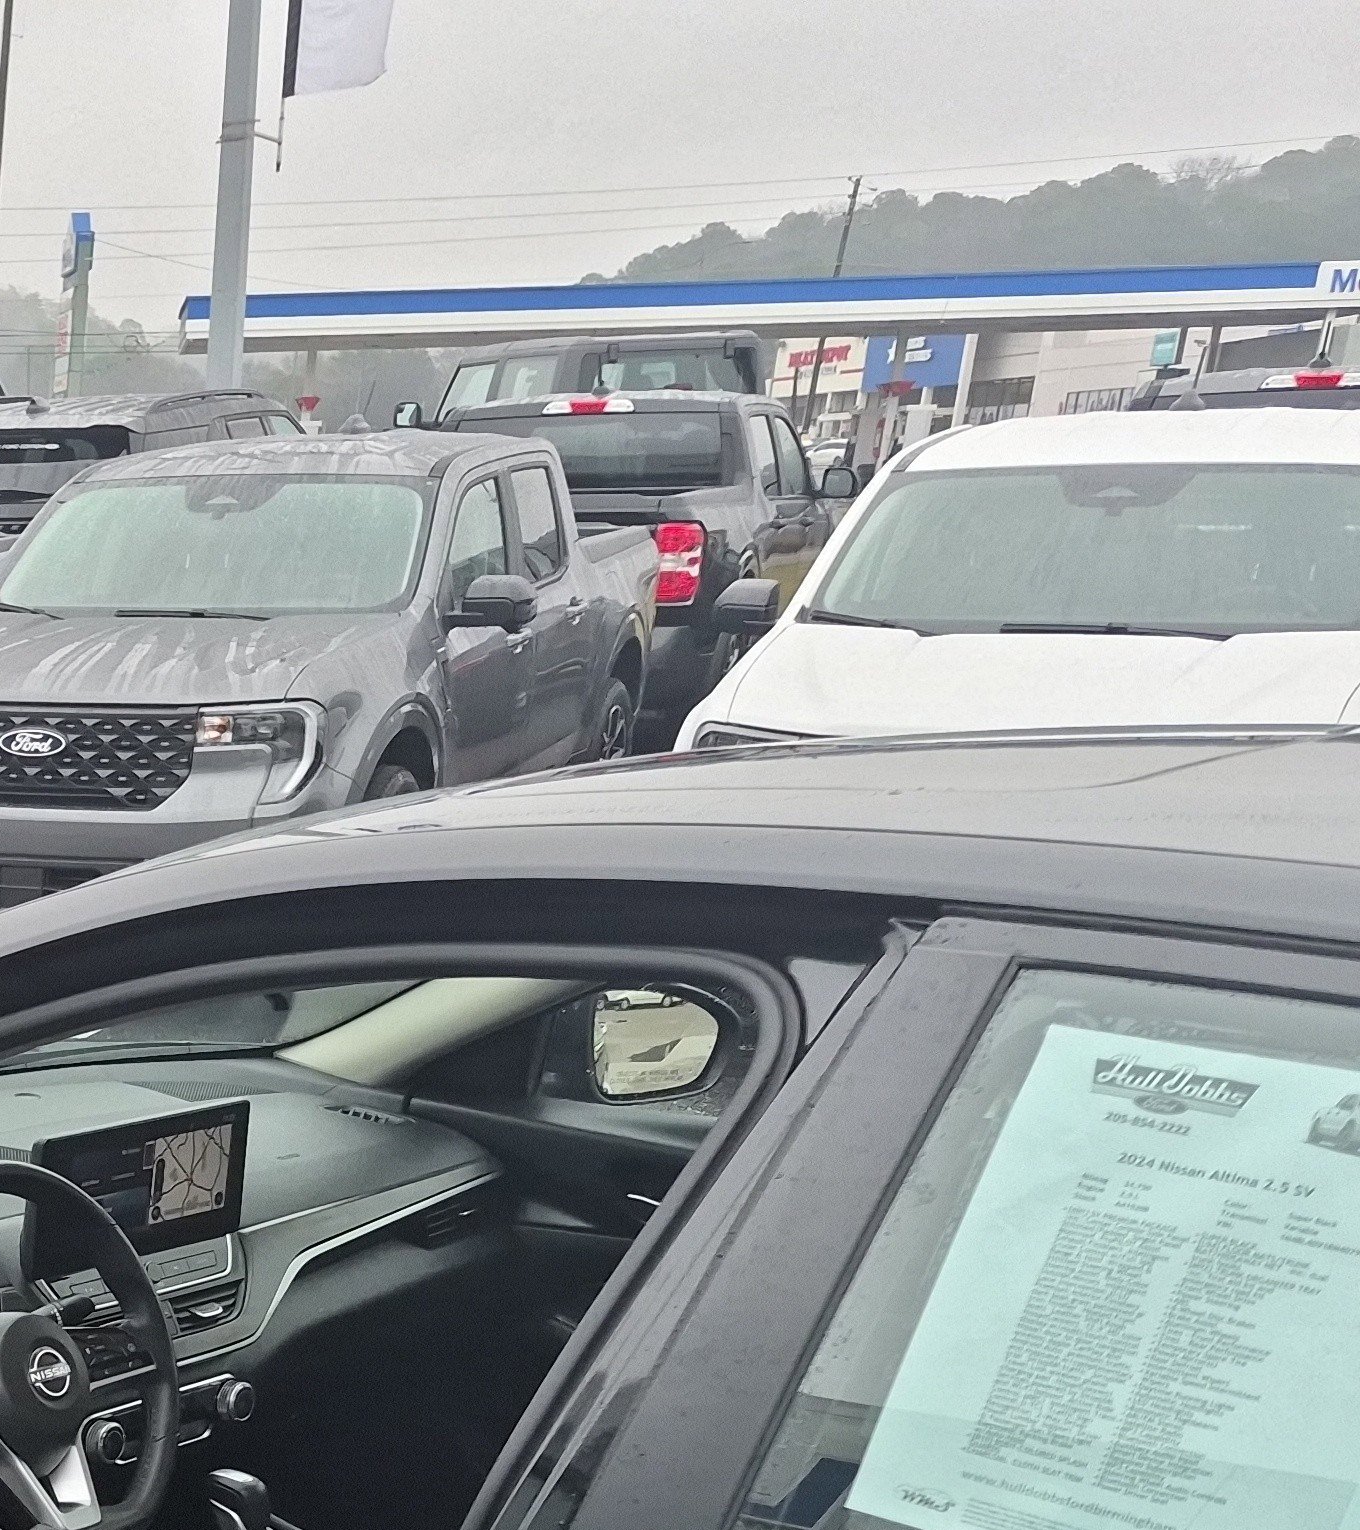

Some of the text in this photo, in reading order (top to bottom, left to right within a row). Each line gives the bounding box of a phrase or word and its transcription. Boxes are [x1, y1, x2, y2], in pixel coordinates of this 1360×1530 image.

[1330, 268, 1360, 293] M
[11, 733, 53, 752] Ford
[1097, 1055, 1249, 1106] Hull Dobbs
[1117, 1152, 1316, 1198] 2024 Nissan Altima 2.5 SV
[30, 1363, 71, 1383] NISSAN
